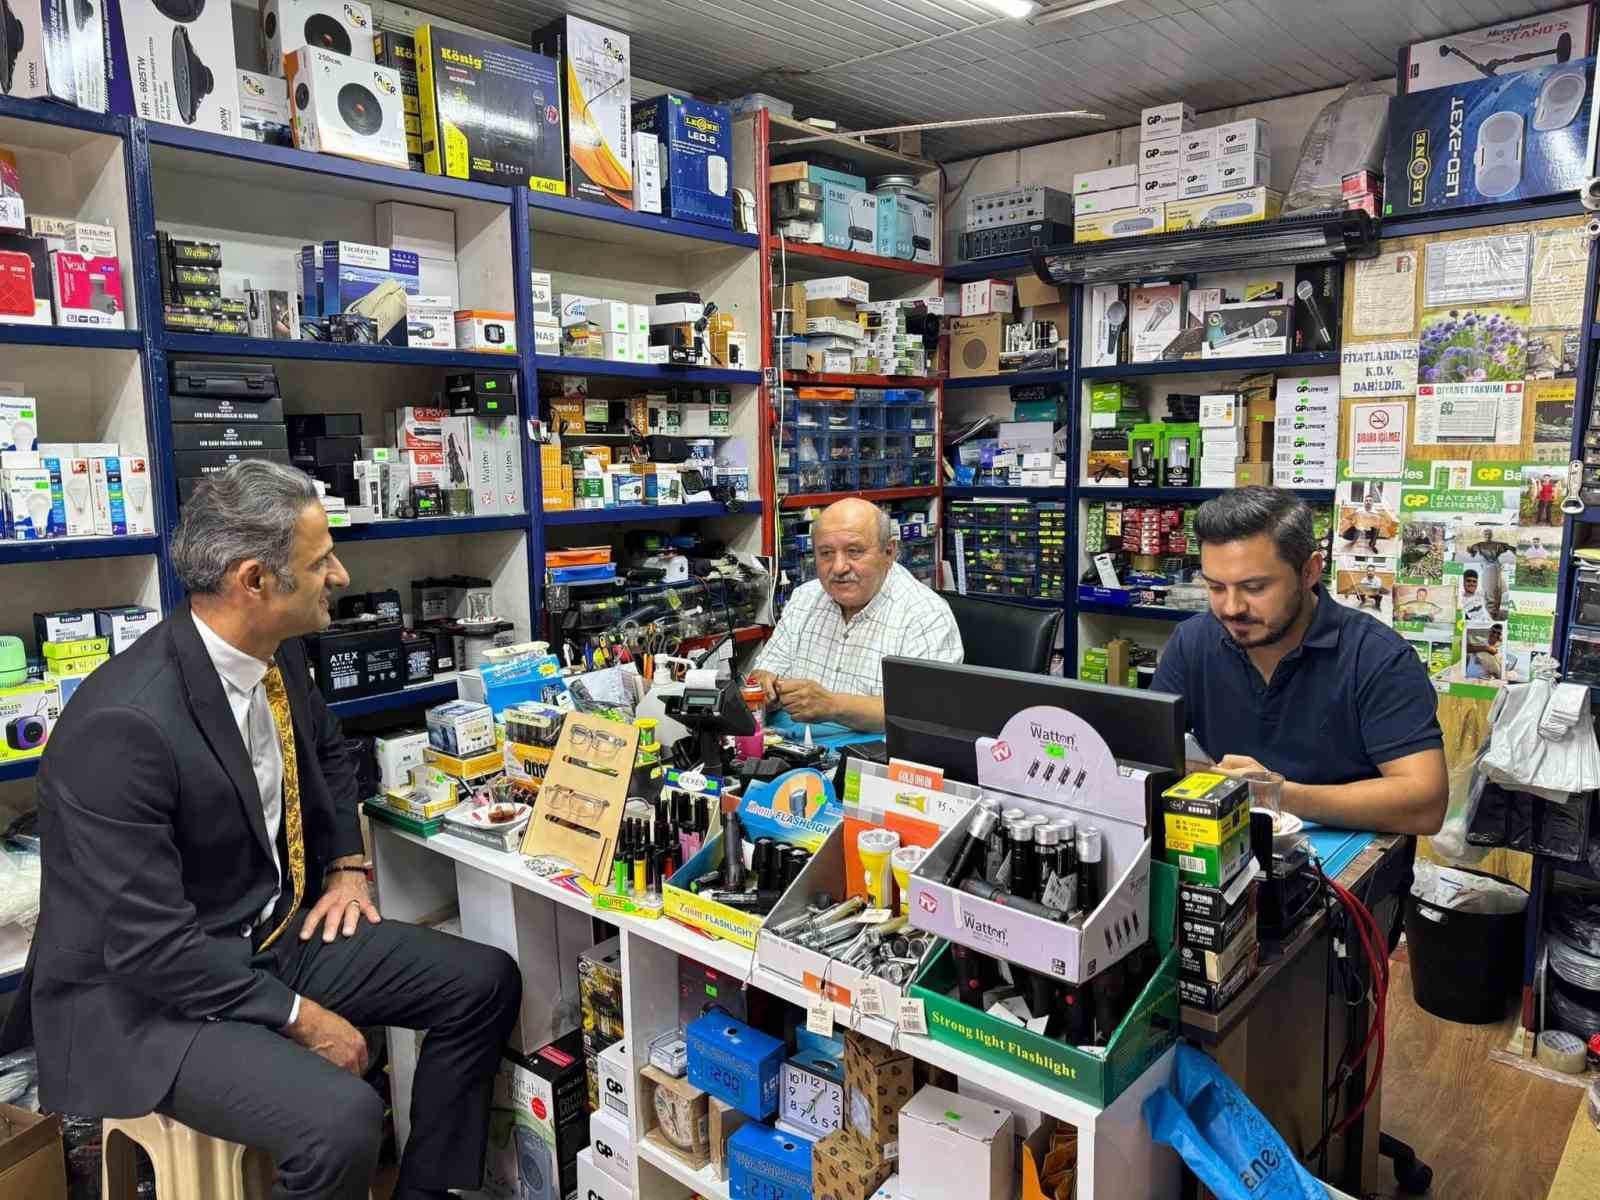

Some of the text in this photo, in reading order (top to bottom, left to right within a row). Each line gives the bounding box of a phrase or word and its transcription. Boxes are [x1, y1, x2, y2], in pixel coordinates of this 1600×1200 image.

[441, 48, 483, 69] König
[1147, 115, 1161, 125] GP
[1226, 134, 1237, 143] GP
[1189, 142, 1200, 150] GP
[1446, 97, 1464, 197] LEO-2X3T
[1146, 148, 1159, 158] GP
[1224, 168, 1236, 176] GP
[1408, 131, 1431, 205] LEONE
[1187, 175, 1198, 183] GP
[1145, 181, 1159, 191] GP
[1477, 467, 1503, 481] GP
[1403, 494, 1428, 507] GP
[330, 651, 358, 664] ATEX
[1031, 725, 1075, 746] Watton
[776, 811, 831, 833] FLASHLIGH
[963, 915, 1007, 940] Watton
[932, 1010, 1078, 1080] Strong light Flashlight
[790, 1072, 800, 1084] 10
[801, 1073, 807, 1084] 11
[811, 1076, 820, 1088] 12
[606, 1078, 624, 1094] GP
[789, 1087, 796, 1096] 9
[824, 1082, 828, 1092] 1
[832, 1091, 840, 1101] 2
[790, 1100, 797, 1110] 8
[833, 1105, 840, 1116] 3
[800, 1108, 807, 1117] 7
[811, 1115, 818, 1124] 6
[822, 1117, 829, 1128] 5
[832, 1120, 839, 1128] 4
[596, 1140, 614, 1158] GP
